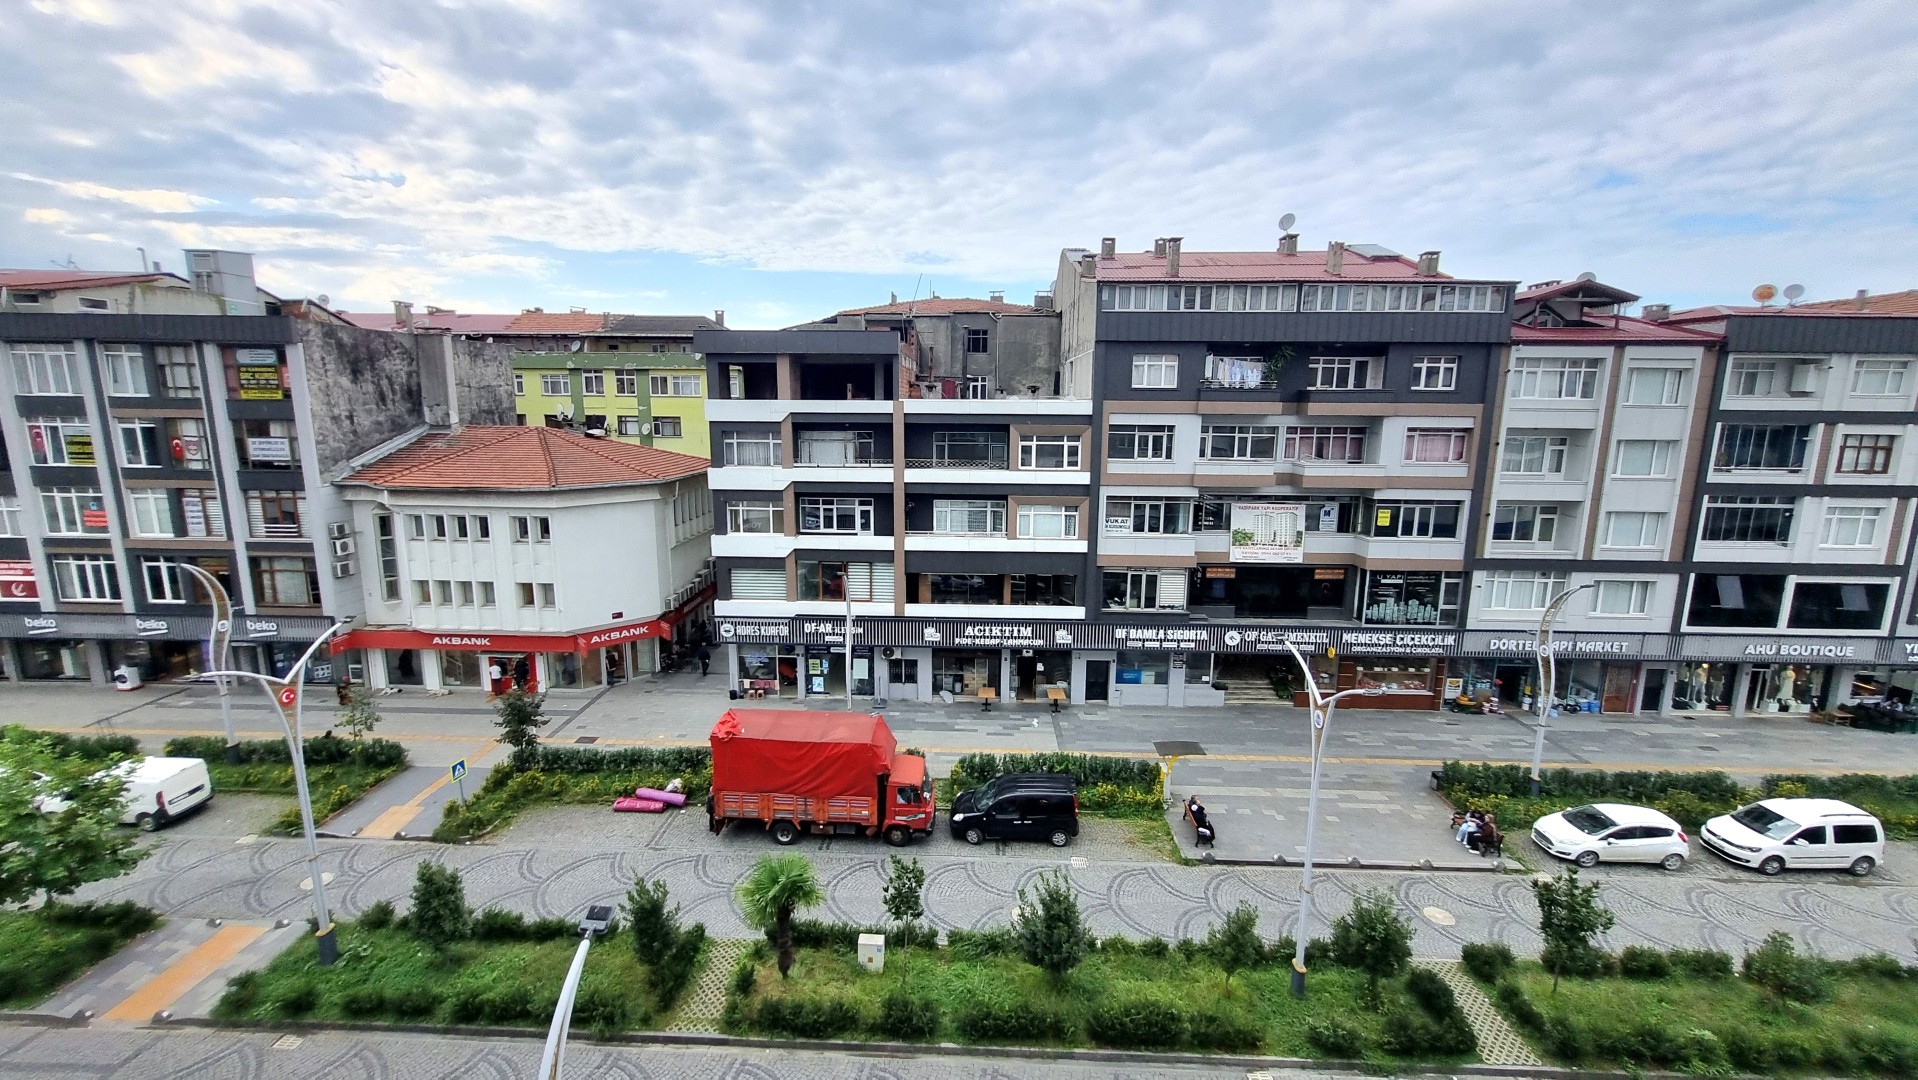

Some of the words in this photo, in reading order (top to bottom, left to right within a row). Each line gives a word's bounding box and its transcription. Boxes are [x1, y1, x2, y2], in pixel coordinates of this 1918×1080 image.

[24, 617, 56, 627] beko
[136, 619, 167, 629] beko
[246, 620, 276, 631] beko
[591, 626, 649, 643] AKBANK
[761, 625, 789, 636] KUAFÖR
[964, 625, 1033, 637] ACIKTIM
[1115, 628, 1127, 639] OF
[1129, 628, 1165, 640] DAMLA
[432, 636, 490, 646] AKBANK
[1244, 631, 1258, 641] OF
[1260, 631, 1329, 643] GAMENKUL
[1550, 640, 1573, 652] API
[1575, 641, 1629, 653] MARKET
[1744, 644, 1776, 655] AHU
[1779, 645, 1855, 657] BOUTIQUE
